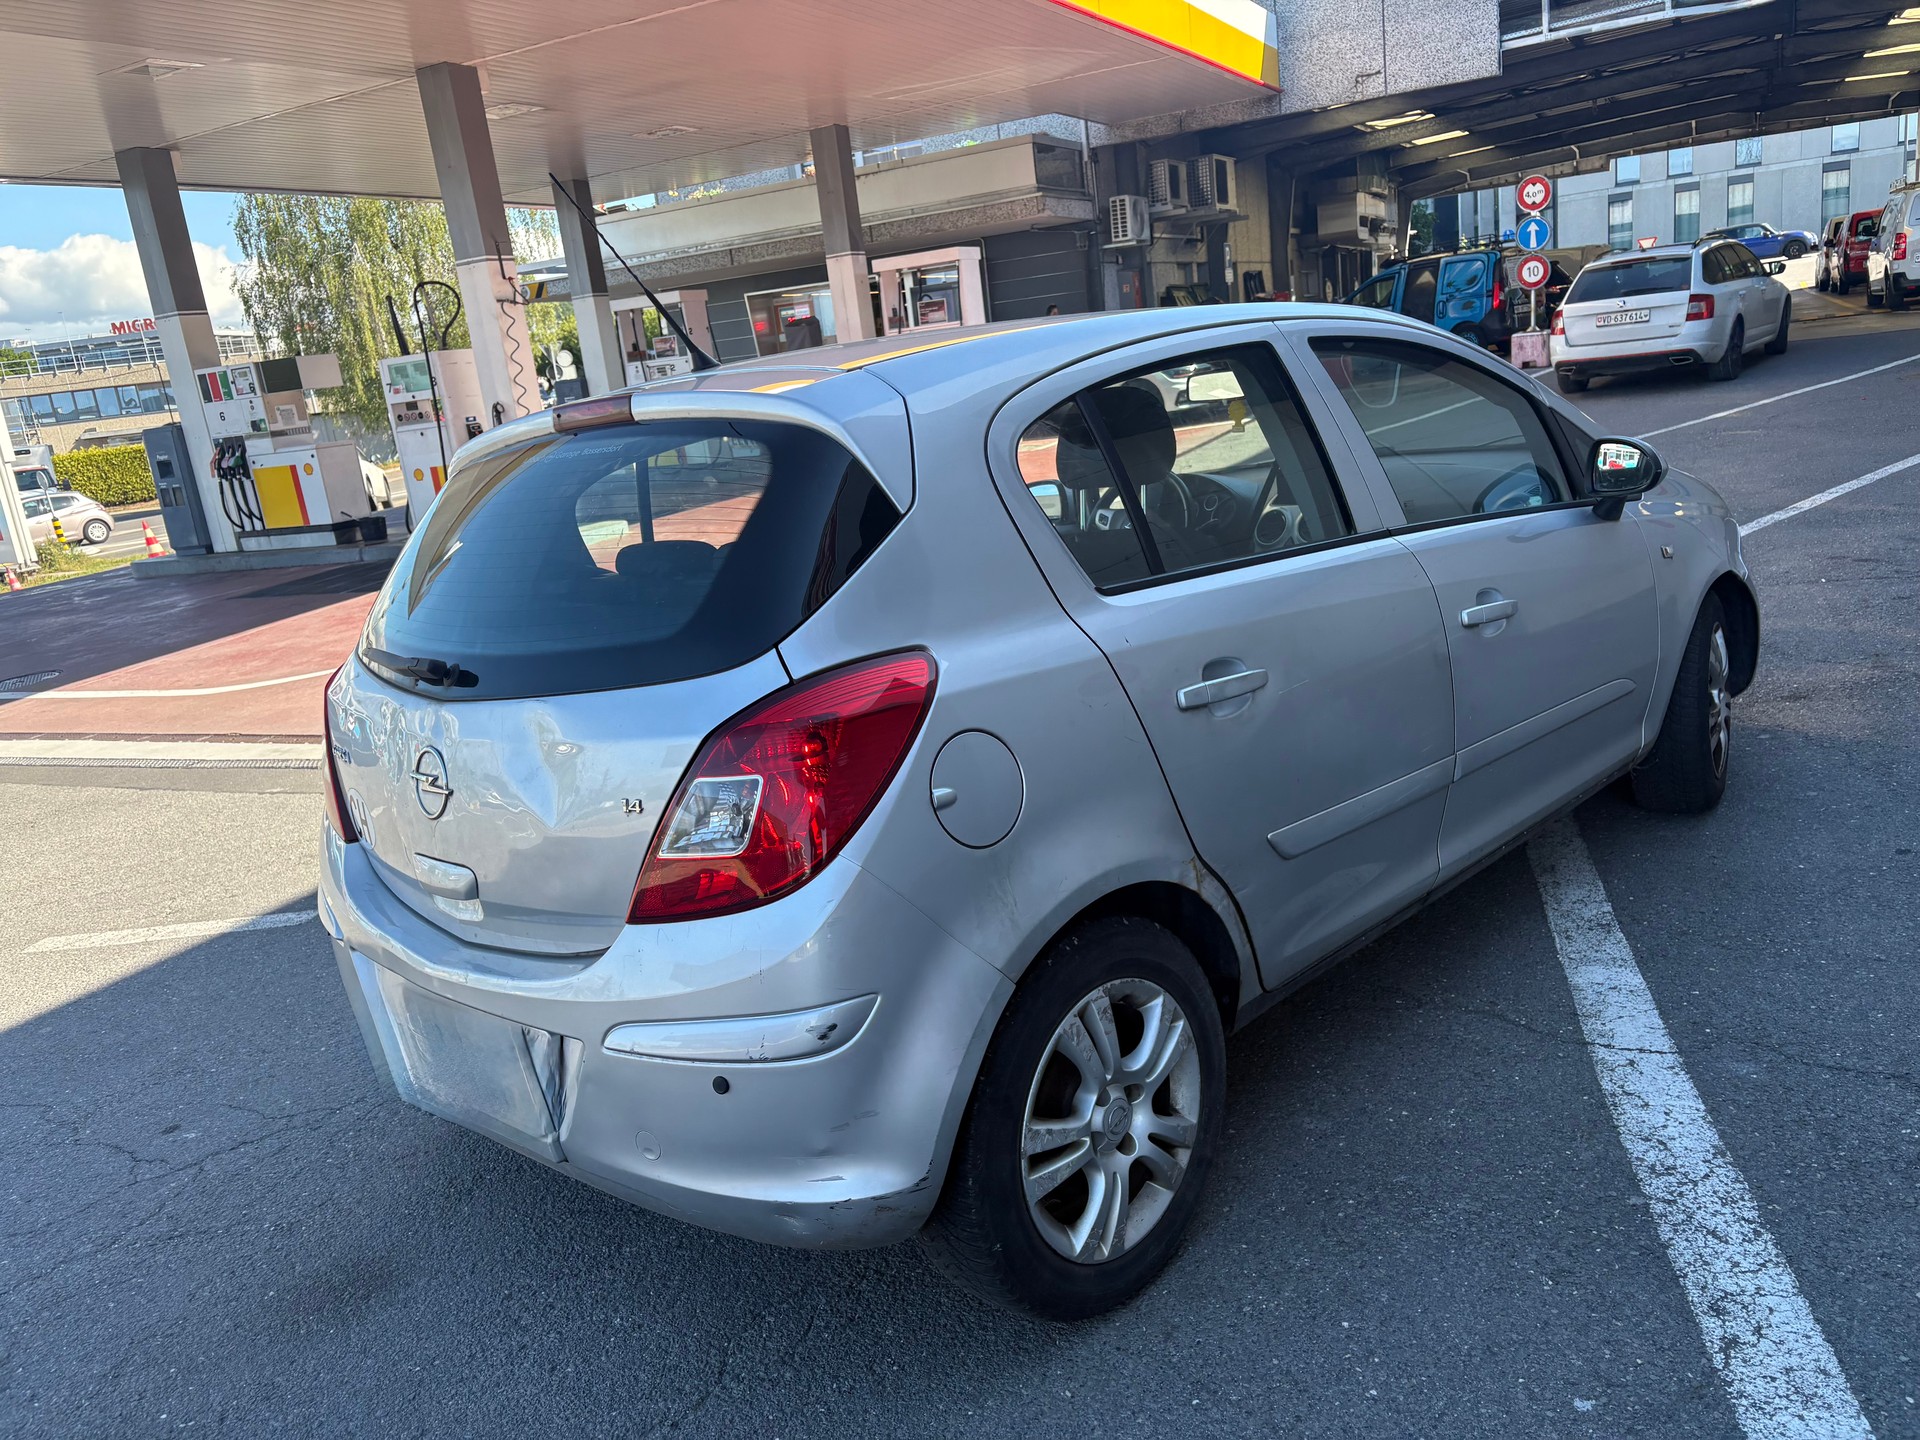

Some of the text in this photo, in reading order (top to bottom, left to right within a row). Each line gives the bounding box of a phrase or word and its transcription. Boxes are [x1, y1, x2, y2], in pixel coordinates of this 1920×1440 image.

[1526, 265, 1540, 278] 10
[110, 318, 157, 335] MIGR
[386, 383, 392, 393] 7
[219, 411, 226, 422] 6
[349, 795, 373, 846] CH
